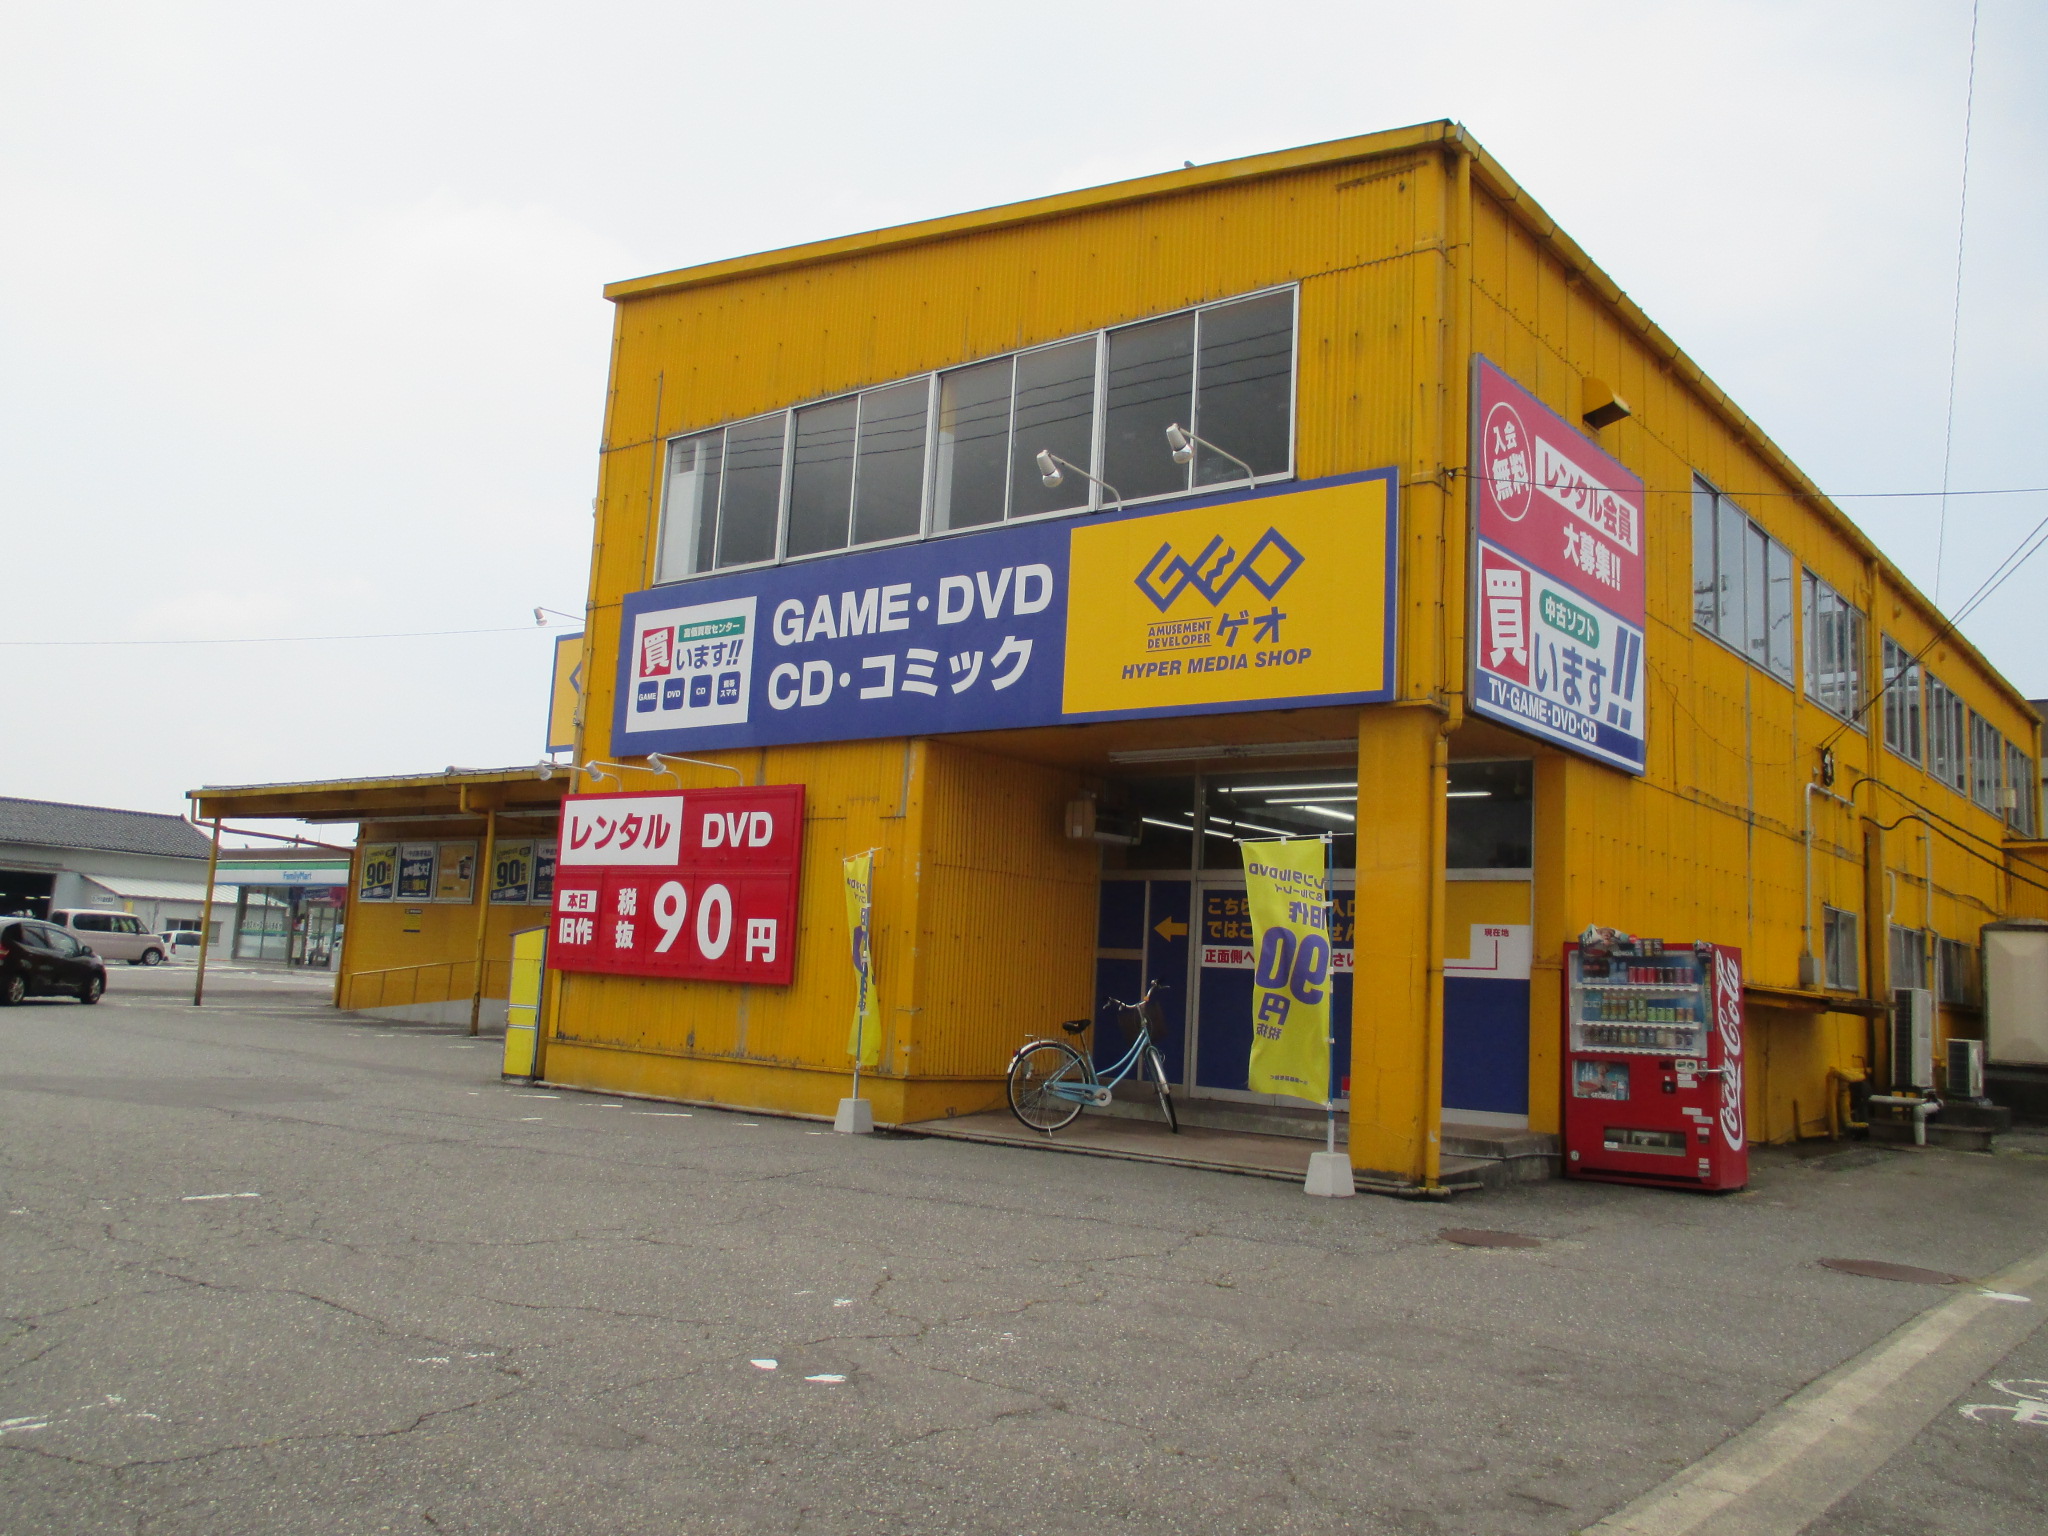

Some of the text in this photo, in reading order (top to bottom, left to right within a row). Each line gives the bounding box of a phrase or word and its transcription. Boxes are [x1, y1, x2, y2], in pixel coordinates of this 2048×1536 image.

[1493, 421, 1517, 455] 入会
[1491, 450, 1529, 502] 無料
[1543, 449, 1633, 548] レンタル会員
[1148, 620, 1212, 637] AMUSEMENT
[1216, 606, 1287, 648] ゲオ
[1545, 596, 1595, 644] 中古ソフト
[1147, 634, 1211, 650] DEVELOPER
[1121, 648, 1312, 680] HYPER MEDIA SHOP
[638, 692, 657, 701] GAME
[667, 689, 681, 699] DVD
[695, 687, 706, 695] CD
[720, 688, 737, 698] スマホ
[569, 811, 773, 851] レンタル DVD
[283, 871, 311, 882] FamilyMart
[367, 861, 386, 886] 90
[497, 859, 520, 887] 90
[566, 892, 589, 910] 本日
[558, 917, 594, 945] 旧作
[653, 880, 733, 960] 90
[746, 918, 777, 962] 円
[1484, 928, 1509, 937] 現在地
